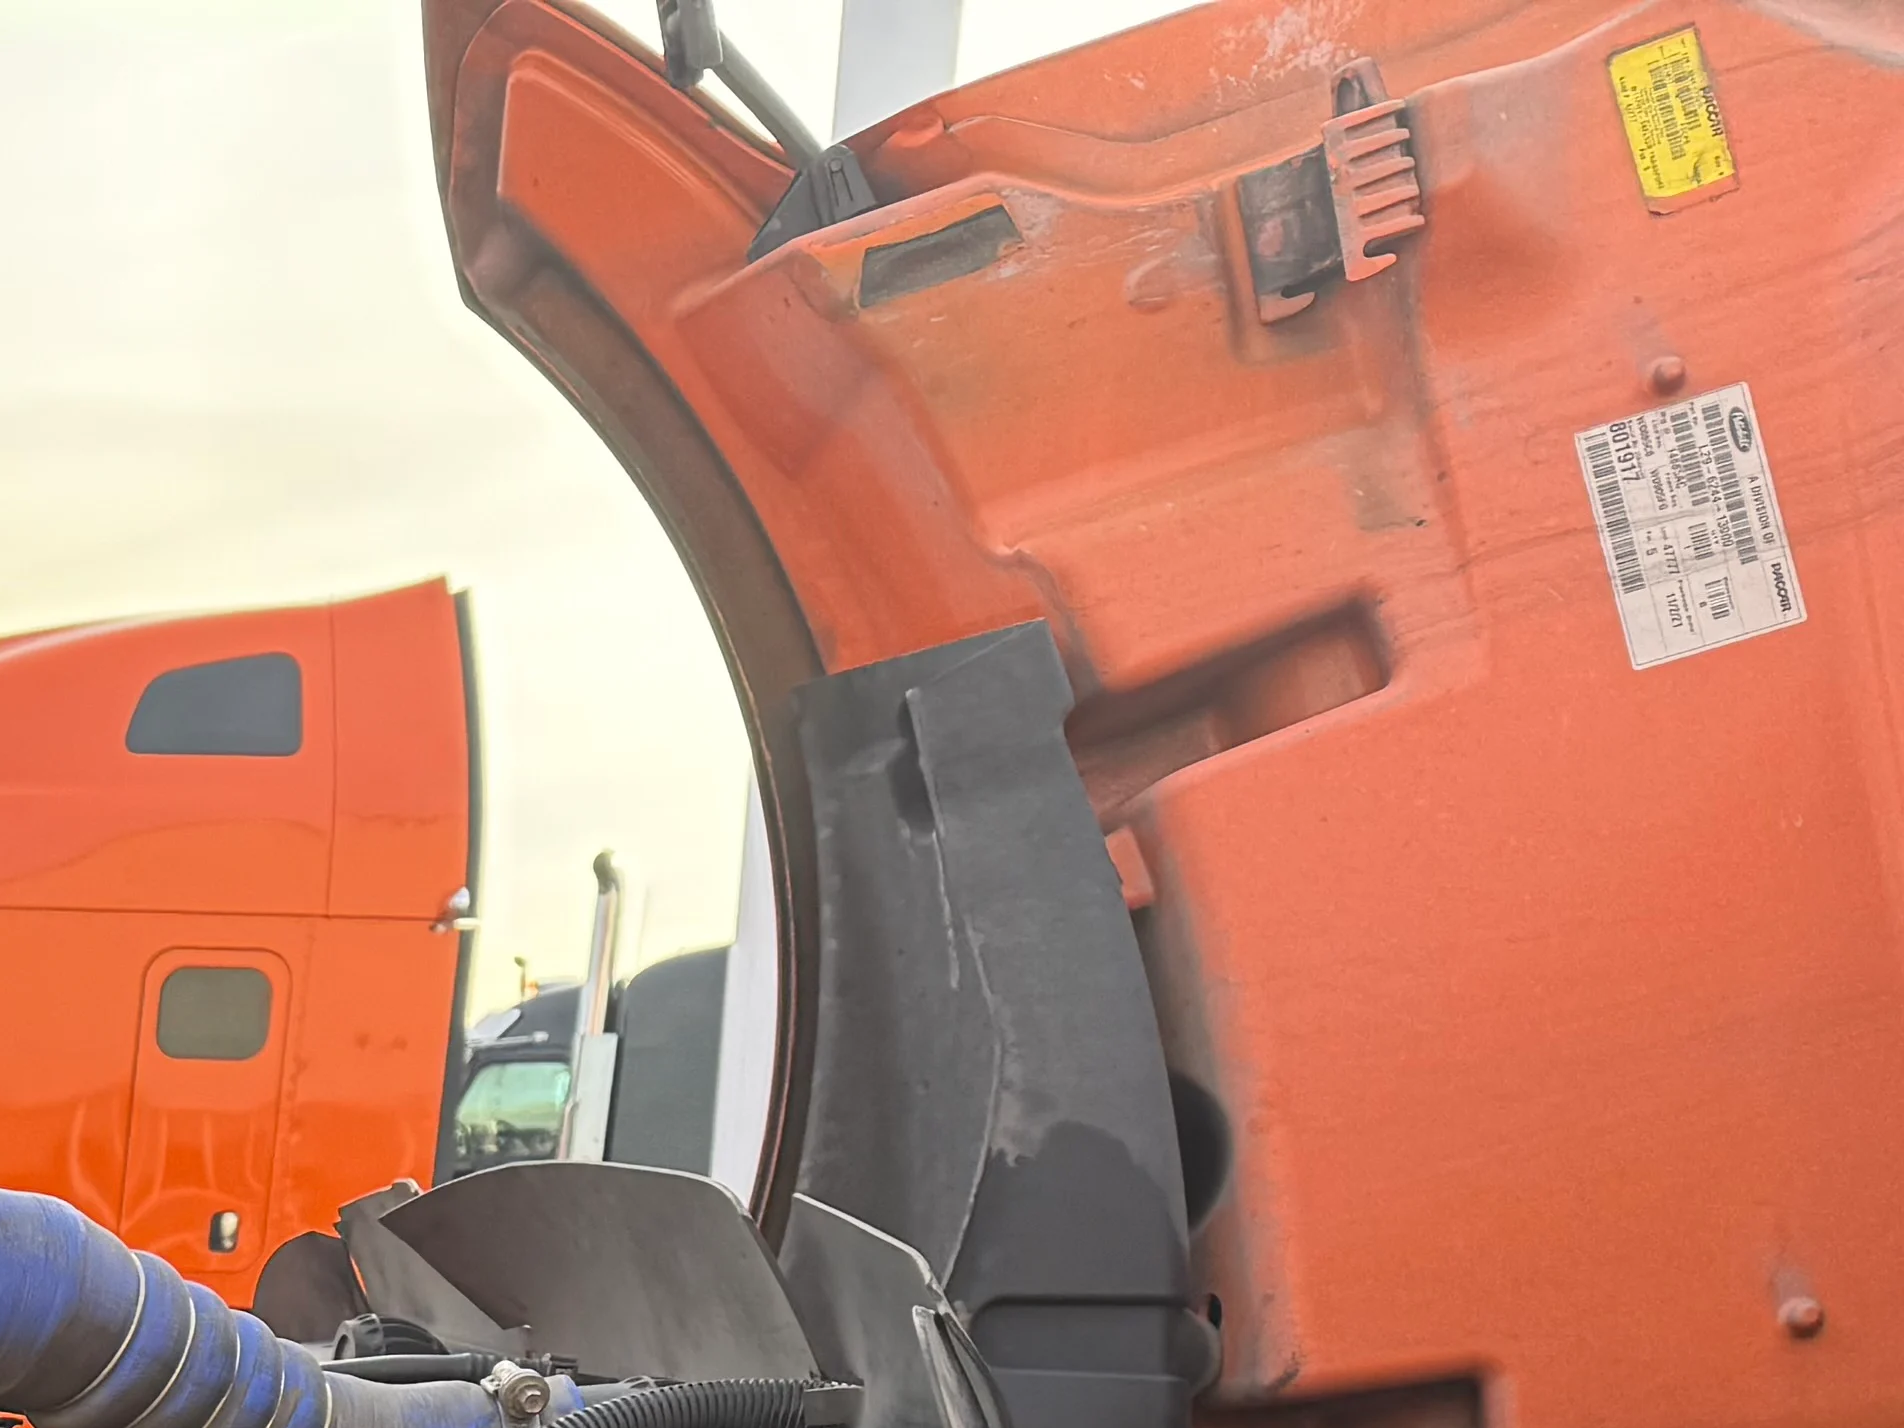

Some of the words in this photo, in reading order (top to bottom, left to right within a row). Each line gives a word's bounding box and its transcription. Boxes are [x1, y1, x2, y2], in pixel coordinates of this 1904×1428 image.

[1608, 421, 1641, 484] 801917
[1747, 475, 1760, 483] A
[1749, 483, 1773, 530] DIVISION
[1761, 531, 1776, 545] OF
[1771, 562, 1792, 612] PACCAR
